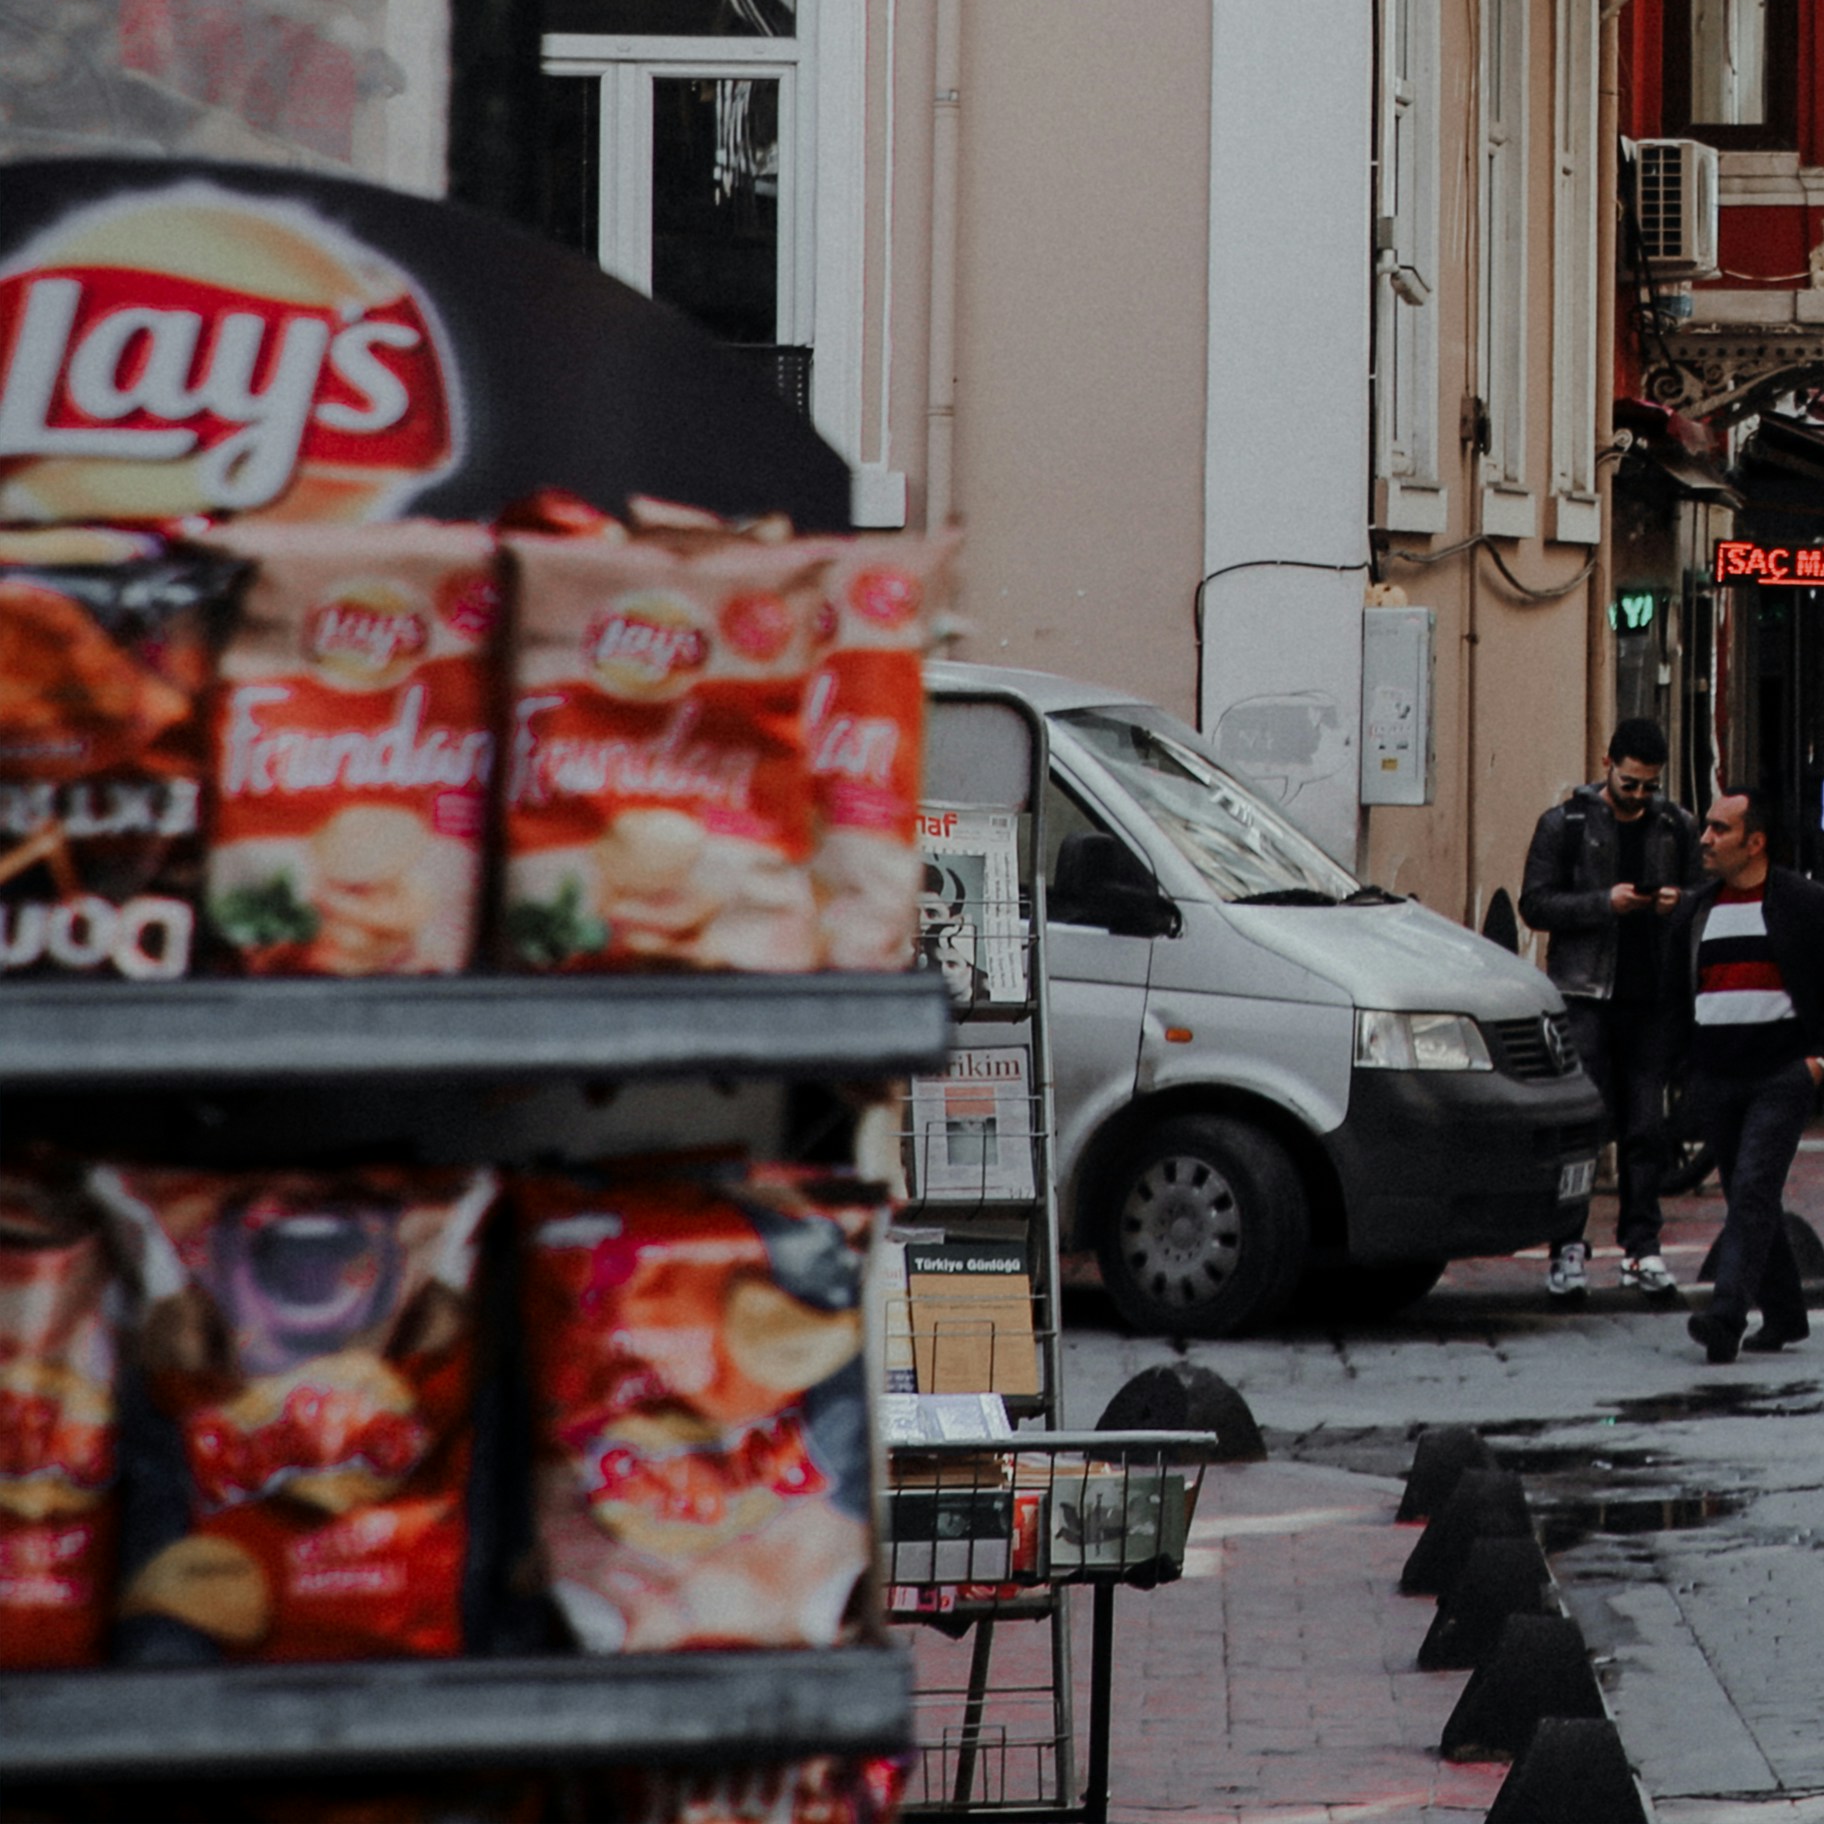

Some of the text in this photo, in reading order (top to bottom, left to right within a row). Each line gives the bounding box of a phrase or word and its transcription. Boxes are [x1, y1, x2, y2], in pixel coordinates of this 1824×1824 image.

[0, 278, 421, 508] Lay's
[1726, 548, 1789, 581] SAÇ
[914, 1258, 1021, 1273] Türkiye Günlüğü
